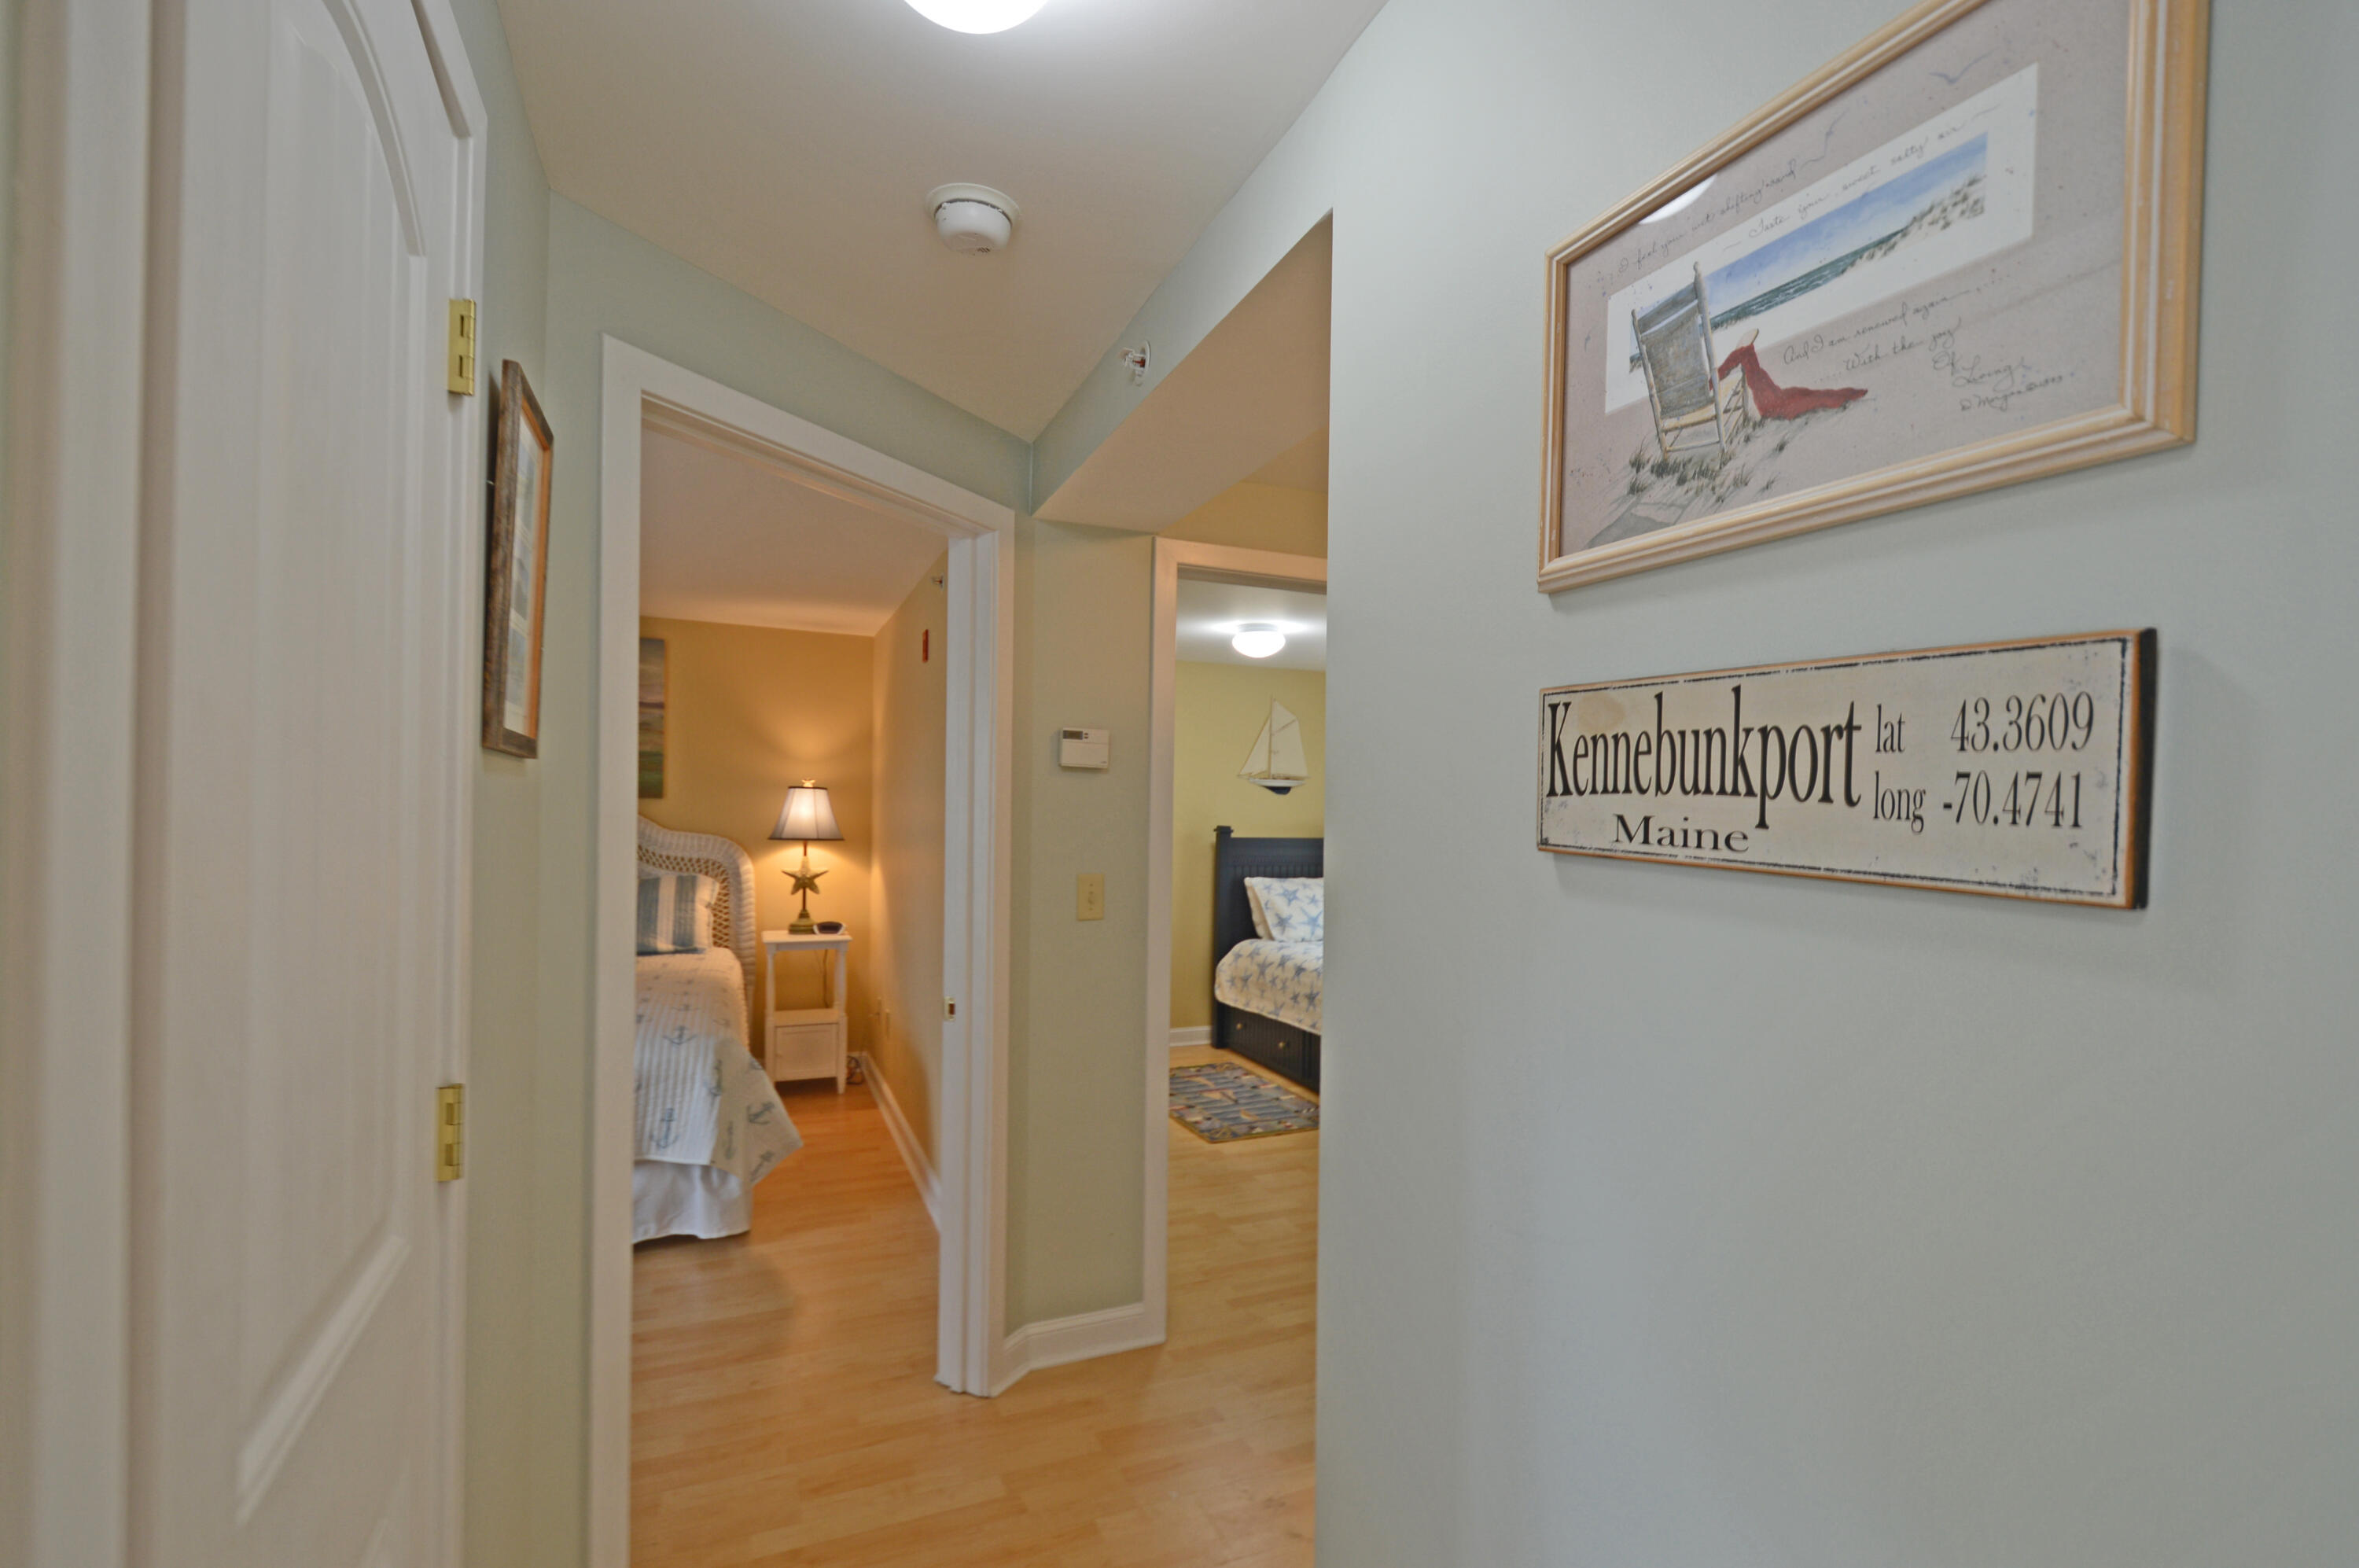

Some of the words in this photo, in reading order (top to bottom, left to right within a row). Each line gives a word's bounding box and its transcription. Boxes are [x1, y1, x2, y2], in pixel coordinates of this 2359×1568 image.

[1875, 703, 1906, 755] lat
[1949, 690, 2096, 753] 43.3609
[1545, 683, 1862, 830] Kennebunkport
[1612, 812, 1750, 853] Maine
[1873, 770, 1927, 834] long
[1941, 769, 2084, 829] -70.4741
